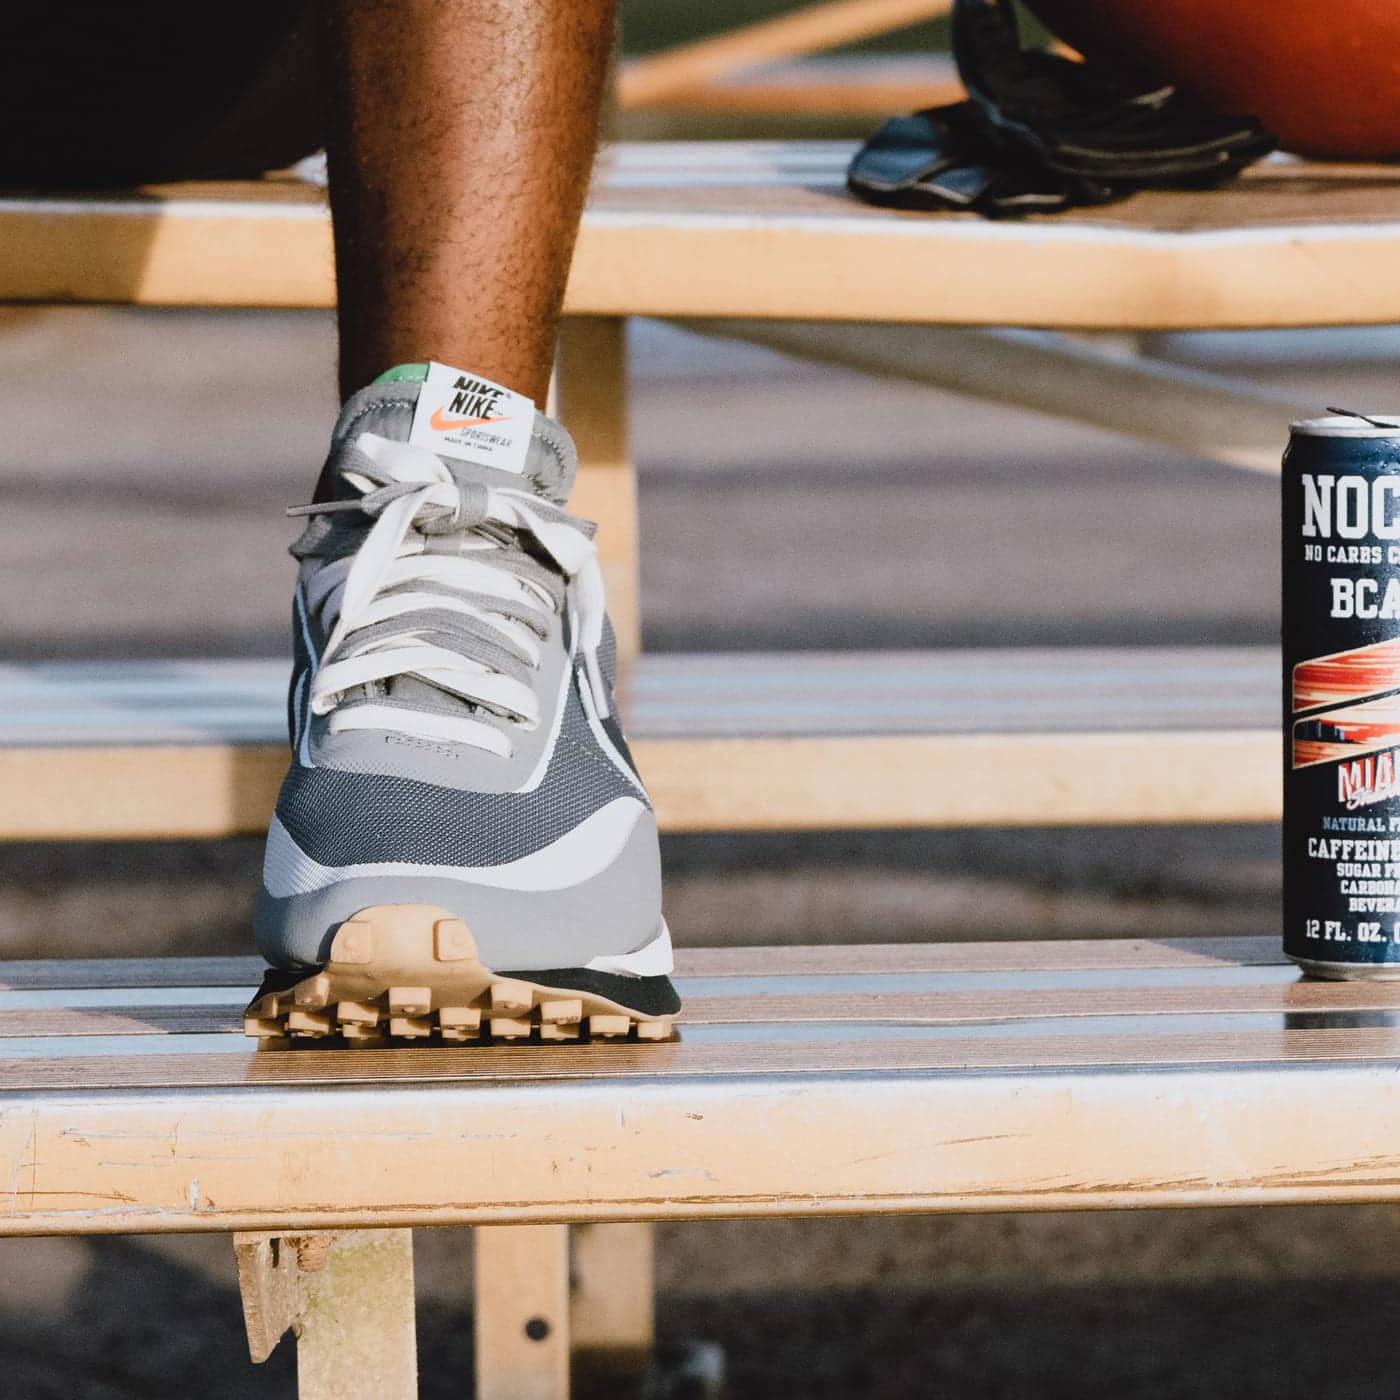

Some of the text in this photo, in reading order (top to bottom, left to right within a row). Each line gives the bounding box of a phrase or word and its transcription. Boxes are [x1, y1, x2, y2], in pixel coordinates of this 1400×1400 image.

[448, 392, 498, 420] NIKE
[1304, 544, 1322, 561] NO
[1327, 545, 1382, 564] CARBS
[1323, 815, 1386, 832] NATURAL
[1337, 863, 1381, 878] SUGAR
[1306, 919, 1320, 938] 12
[1324, 921, 1352, 941] FL.
[1357, 922, 1387, 943] OZ.
